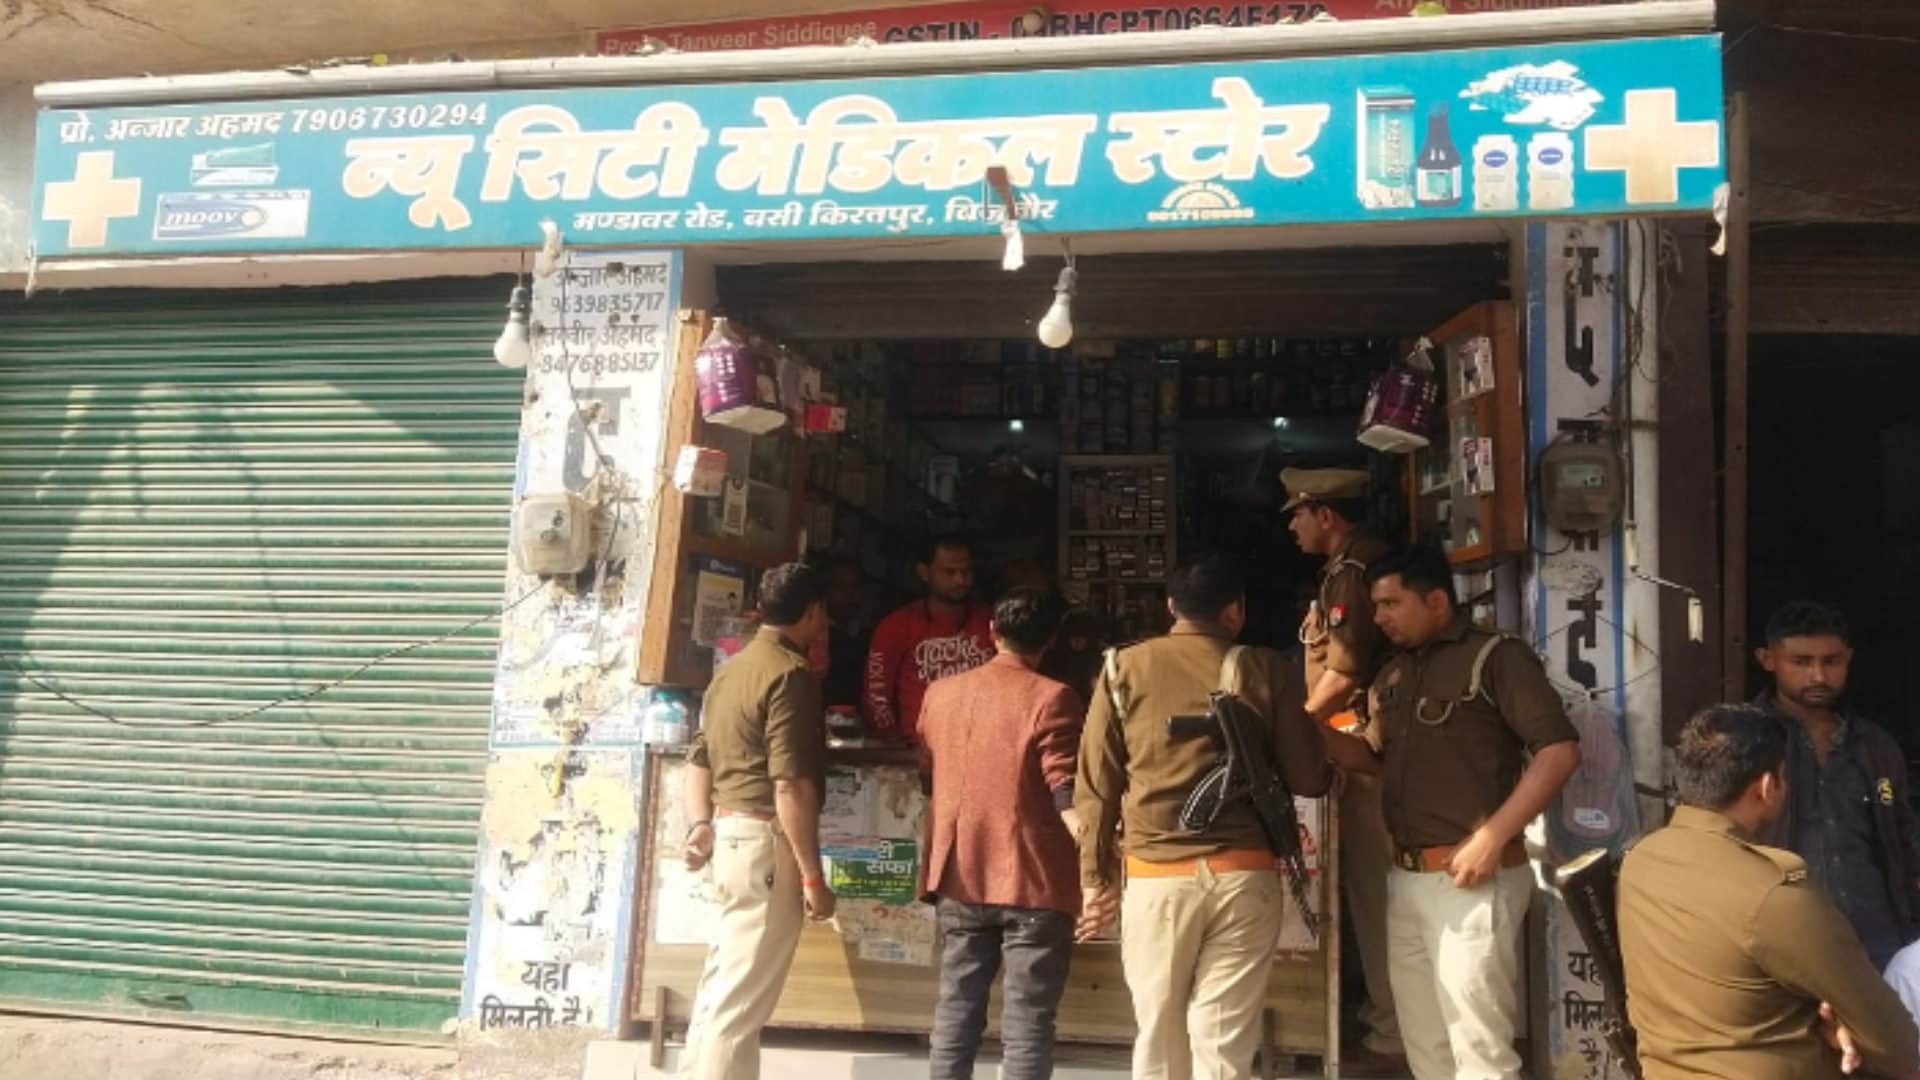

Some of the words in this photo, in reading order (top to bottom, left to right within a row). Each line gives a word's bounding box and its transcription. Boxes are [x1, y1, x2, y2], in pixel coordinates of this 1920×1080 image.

[195, 111, 285, 139] अहमद
[292, 103, 488, 133] 7906730294
[342, 133, 474, 232] न्यू
[480, 101, 708, 201] सिटी
[716, 95, 1098, 197] मेडिकल
[1106, 77, 1331, 184] स्टोर
[166, 208, 238, 226] moov
[1567, 949, 1602, 986] यह
[1563, 990, 1605, 1031] मिल
